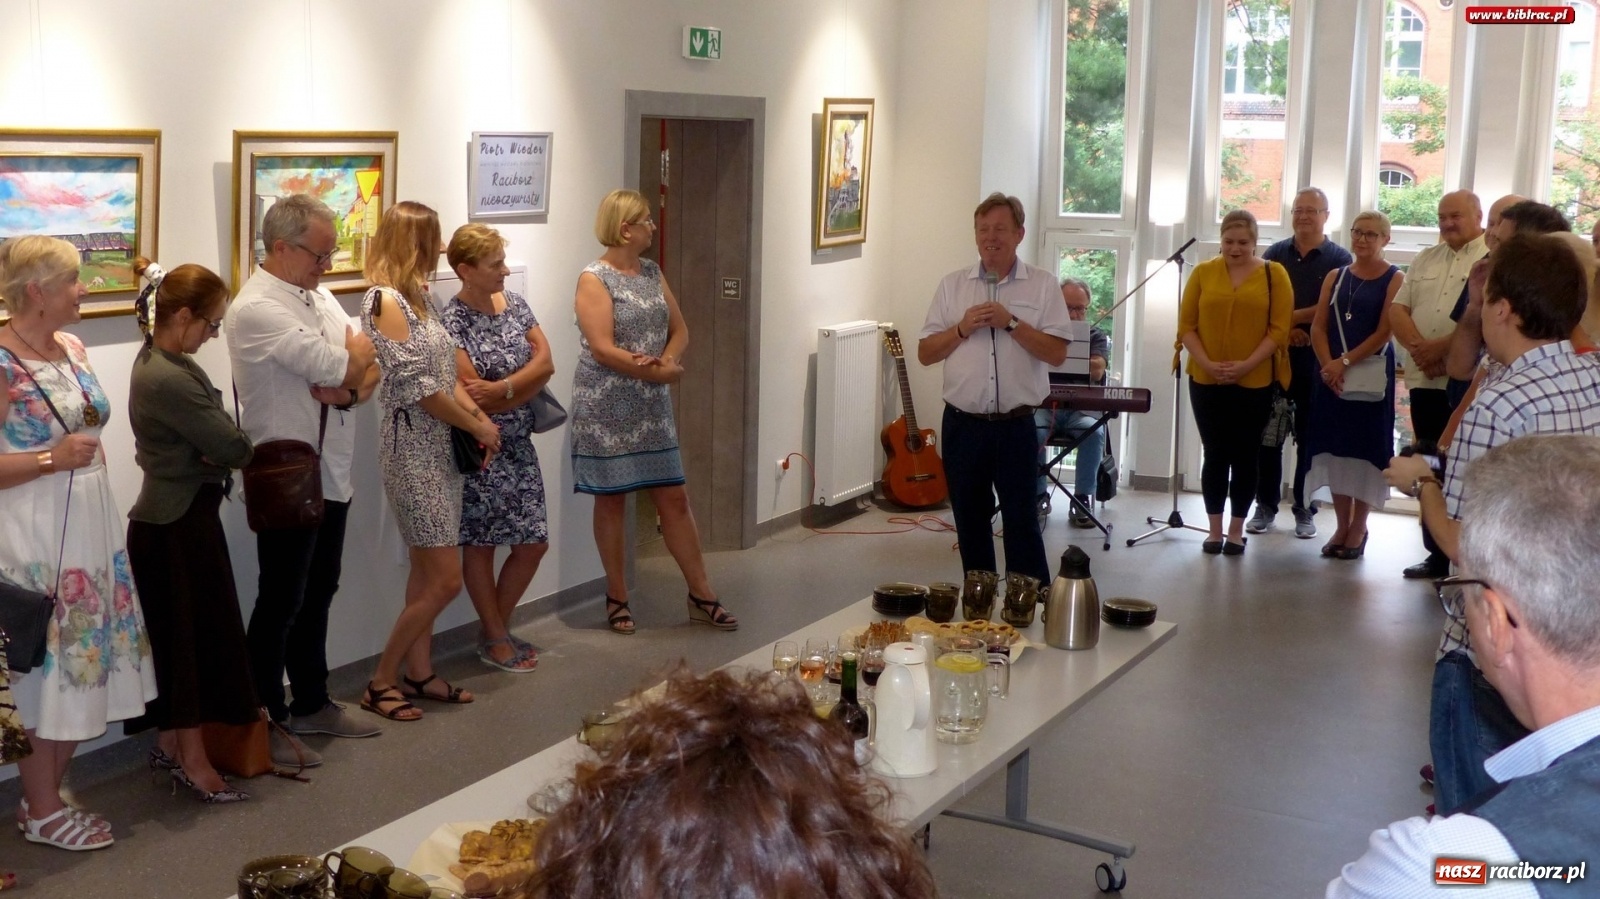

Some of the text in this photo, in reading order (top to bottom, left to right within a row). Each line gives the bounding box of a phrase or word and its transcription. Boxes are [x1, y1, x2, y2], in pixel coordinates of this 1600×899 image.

[480, 142, 544, 156] Piotr Wieder
[480, 191, 541, 207] nieoczywisty
[1103, 388, 1134, 400] KORG
